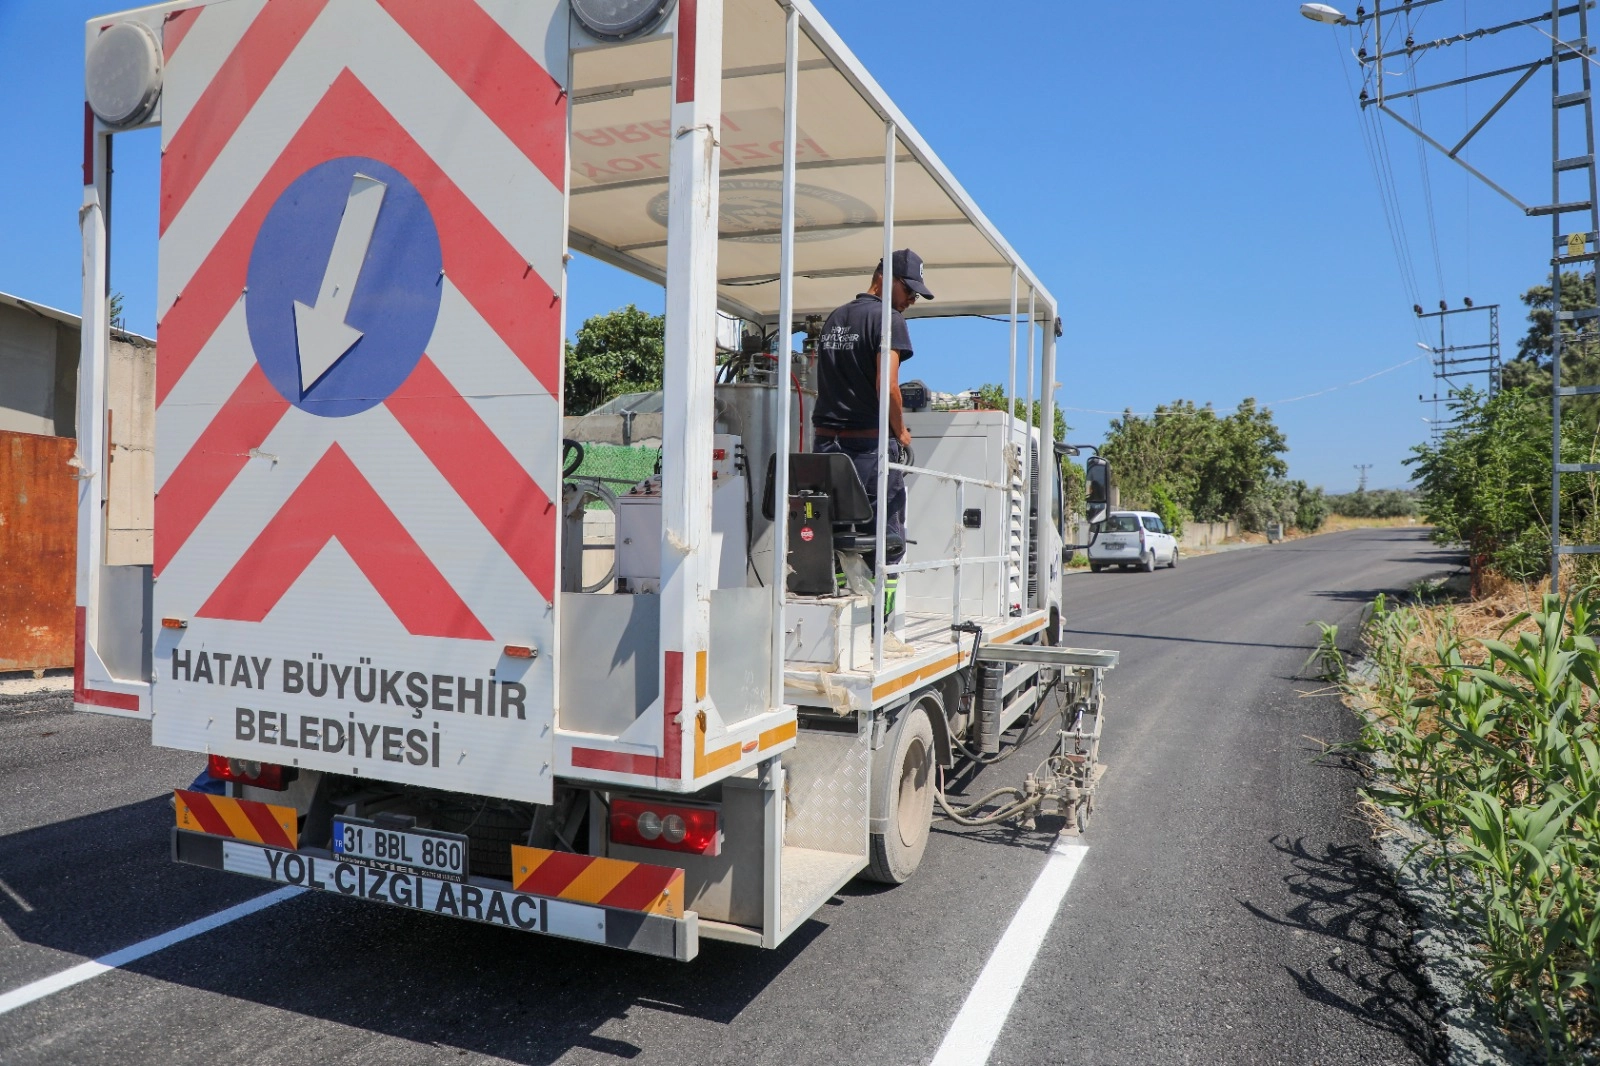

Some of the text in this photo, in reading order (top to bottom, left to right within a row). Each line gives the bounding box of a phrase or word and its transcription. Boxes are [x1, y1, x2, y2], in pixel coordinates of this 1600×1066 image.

[172, 648, 527, 720] HATAY BÜYÜKŞEHİR
[235, 706, 440, 768] BELEDİYESİ
[334, 839, 343, 848] TR
[344, 826, 461, 871] 31 BBL 860
[264, 849, 326, 889] YOL
[435, 881, 549, 932] ARACI
